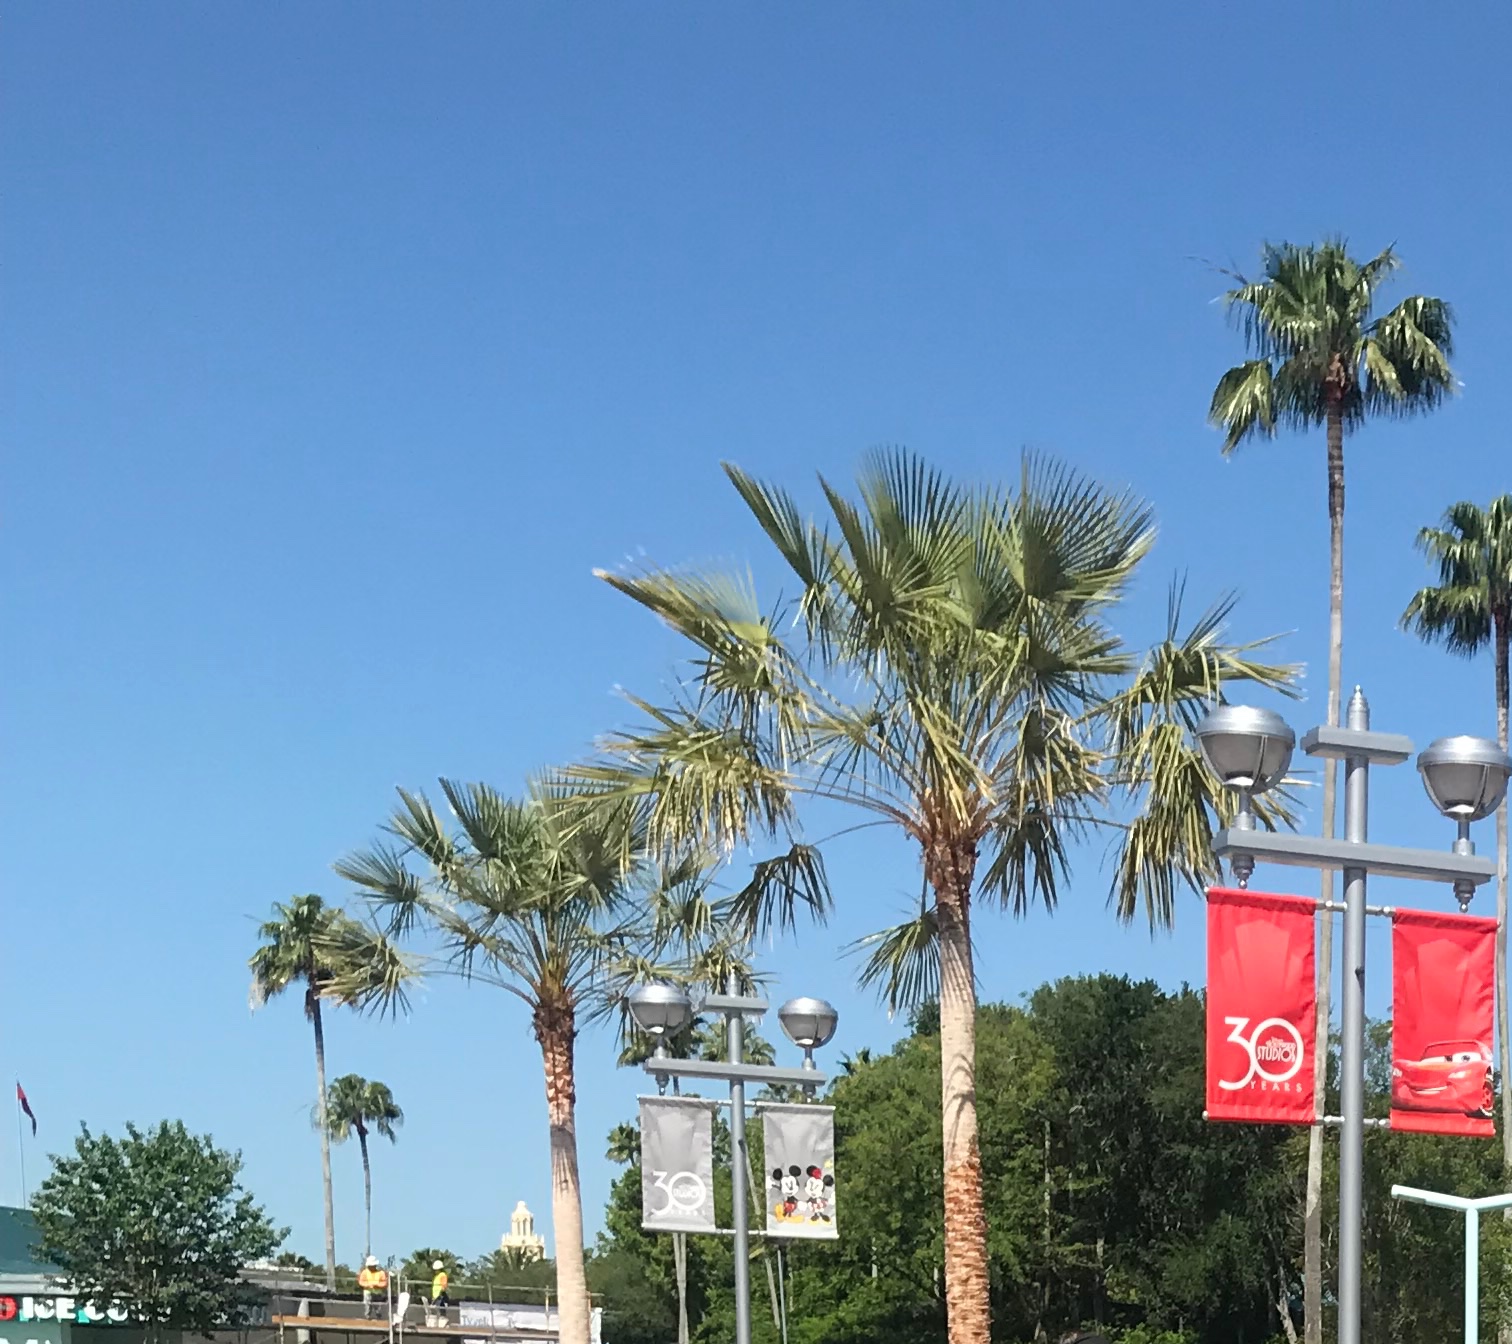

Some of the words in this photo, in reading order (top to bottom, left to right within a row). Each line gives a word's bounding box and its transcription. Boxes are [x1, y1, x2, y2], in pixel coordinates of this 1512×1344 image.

[1218, 1016, 1304, 1091] 30
[1257, 1045, 1297, 1063] STUDIOS
[1250, 1080, 1303, 1093] YEARS
[651, 1170, 707, 1216] 30
[22, 1296, 76, 1319] ICE
